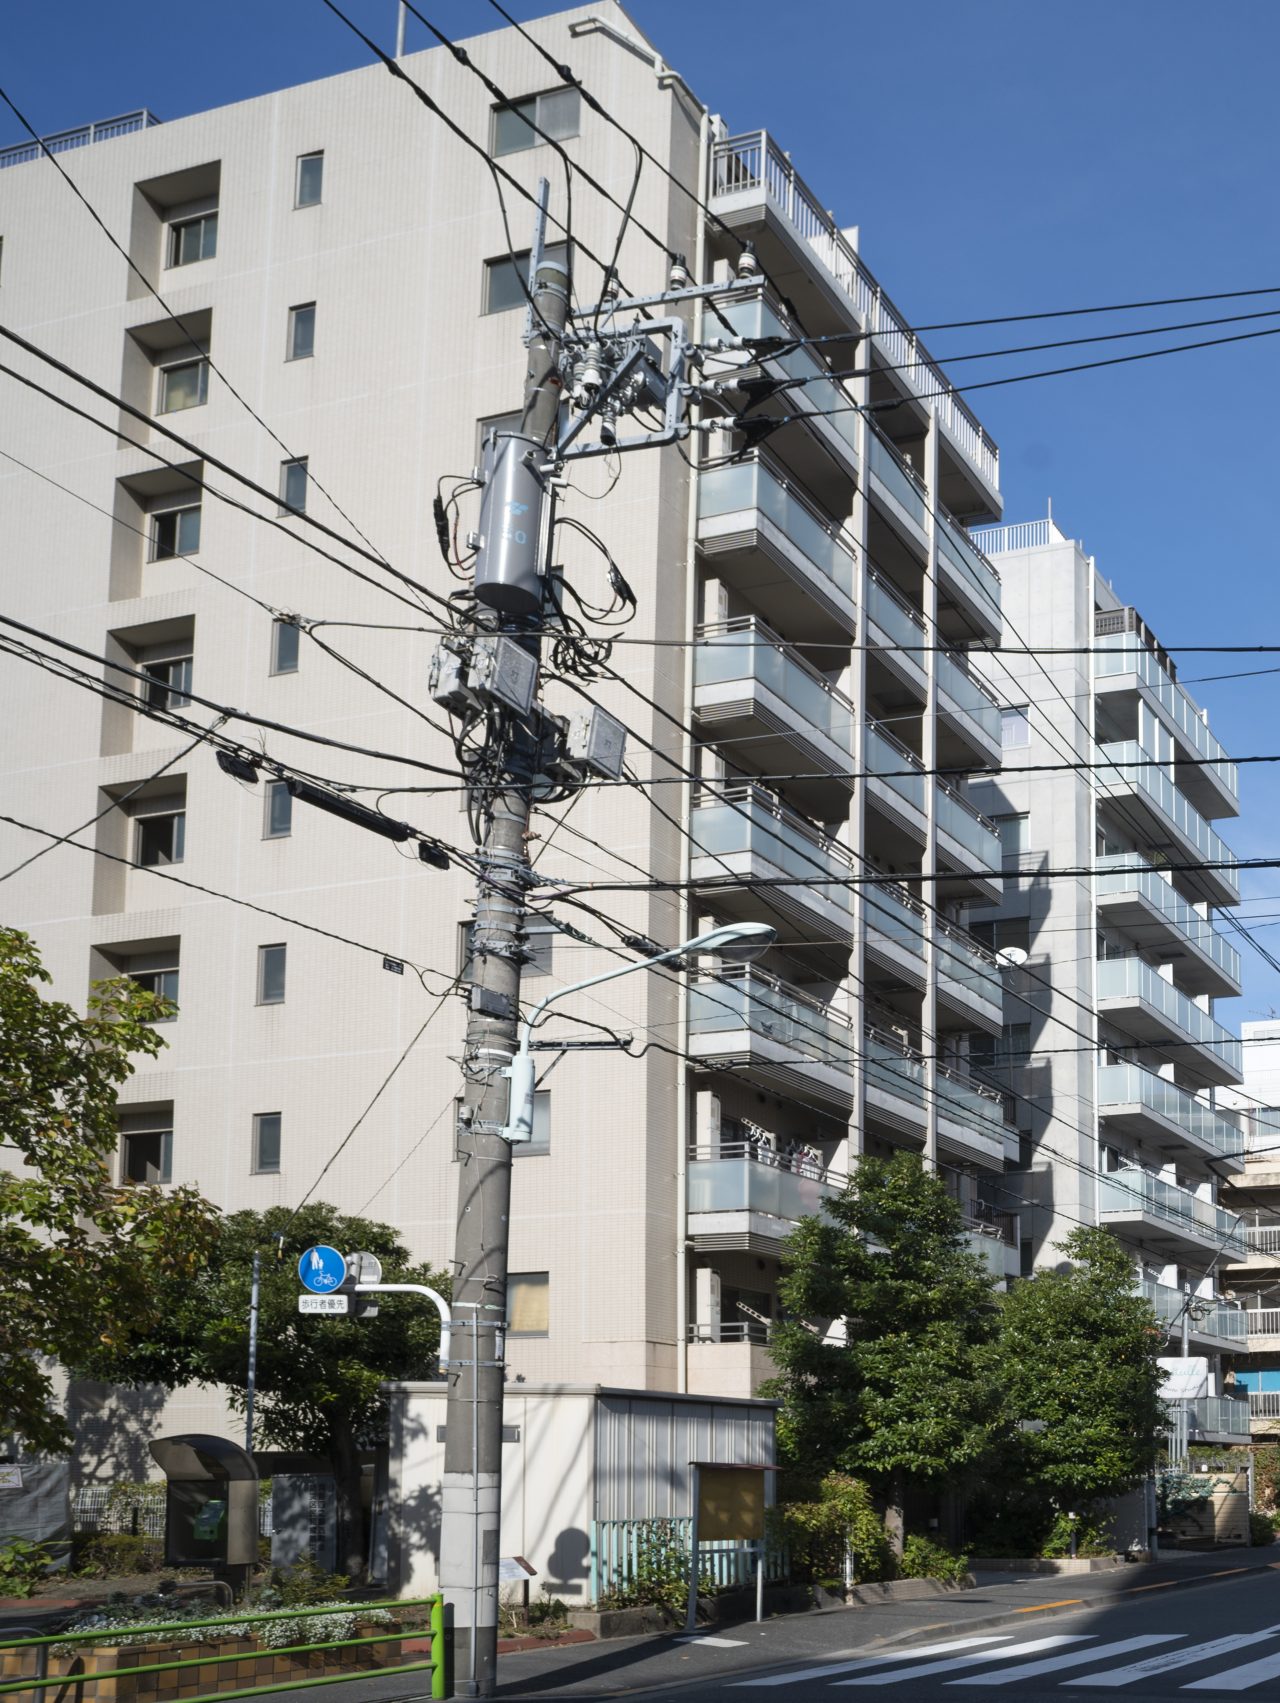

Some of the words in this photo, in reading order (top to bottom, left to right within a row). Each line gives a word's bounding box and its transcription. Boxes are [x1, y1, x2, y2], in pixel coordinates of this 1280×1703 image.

[302, 1298, 345, 1310] 歩行者優先
